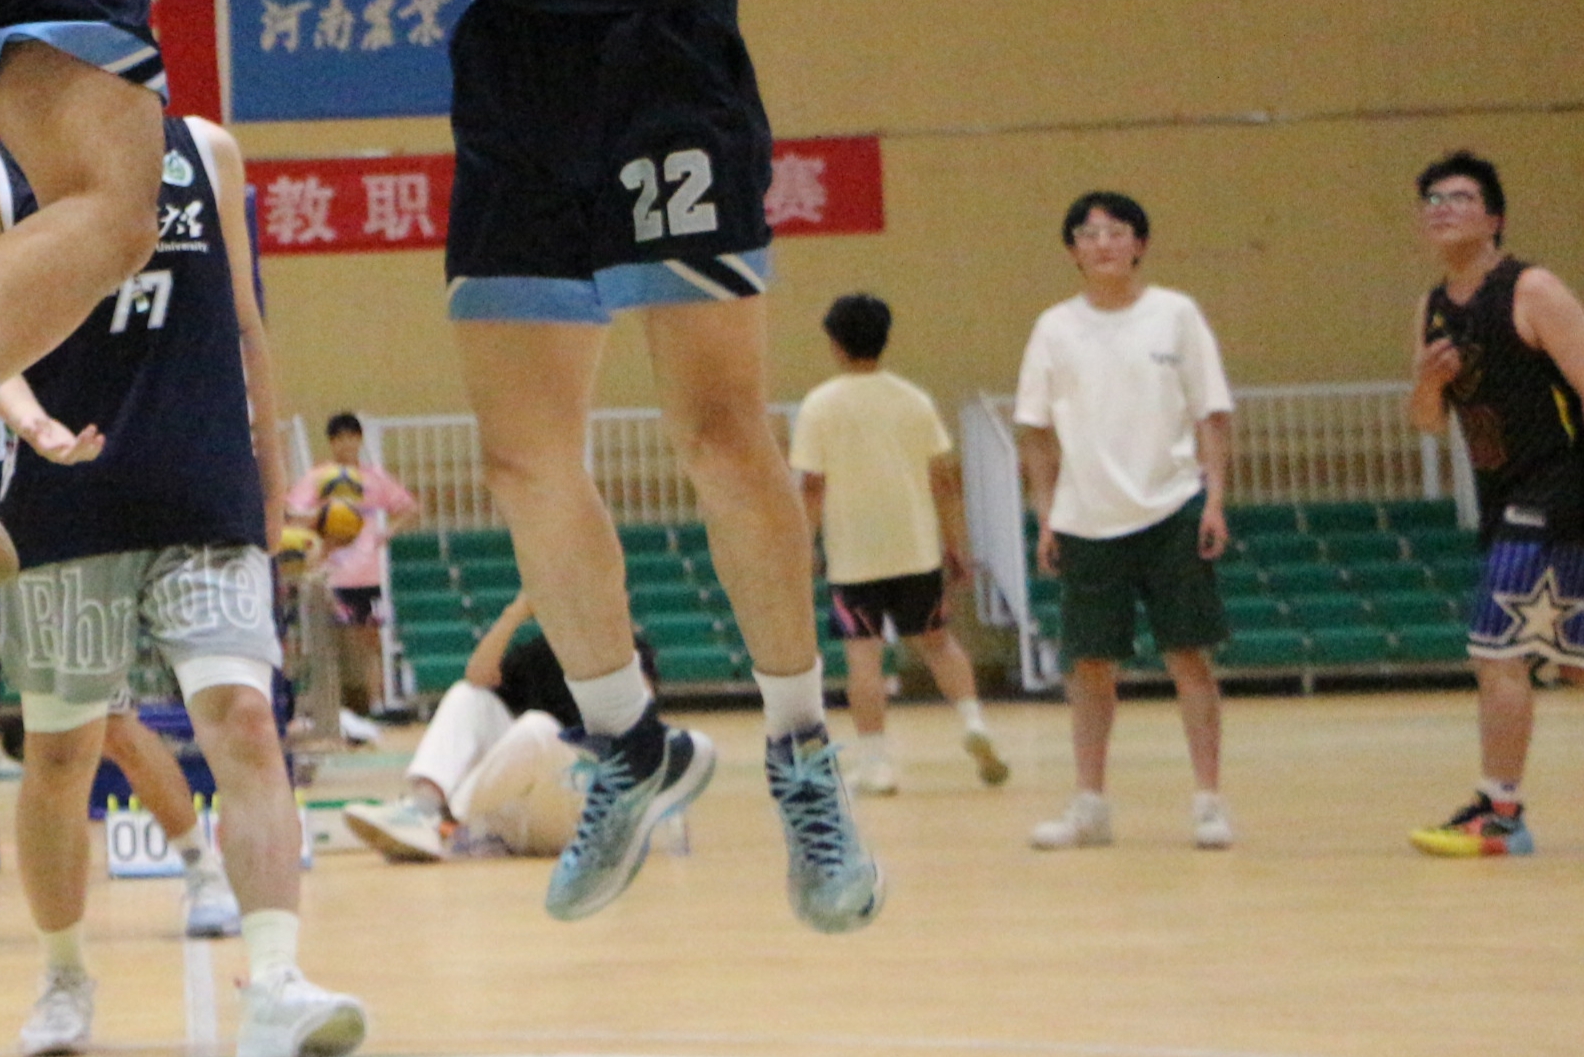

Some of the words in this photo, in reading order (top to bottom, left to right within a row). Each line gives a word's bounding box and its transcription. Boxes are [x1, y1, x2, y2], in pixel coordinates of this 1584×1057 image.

[266, 173, 436, 244] 教职
[619, 148, 717, 243] 22
[113, 820, 168, 862] 00
